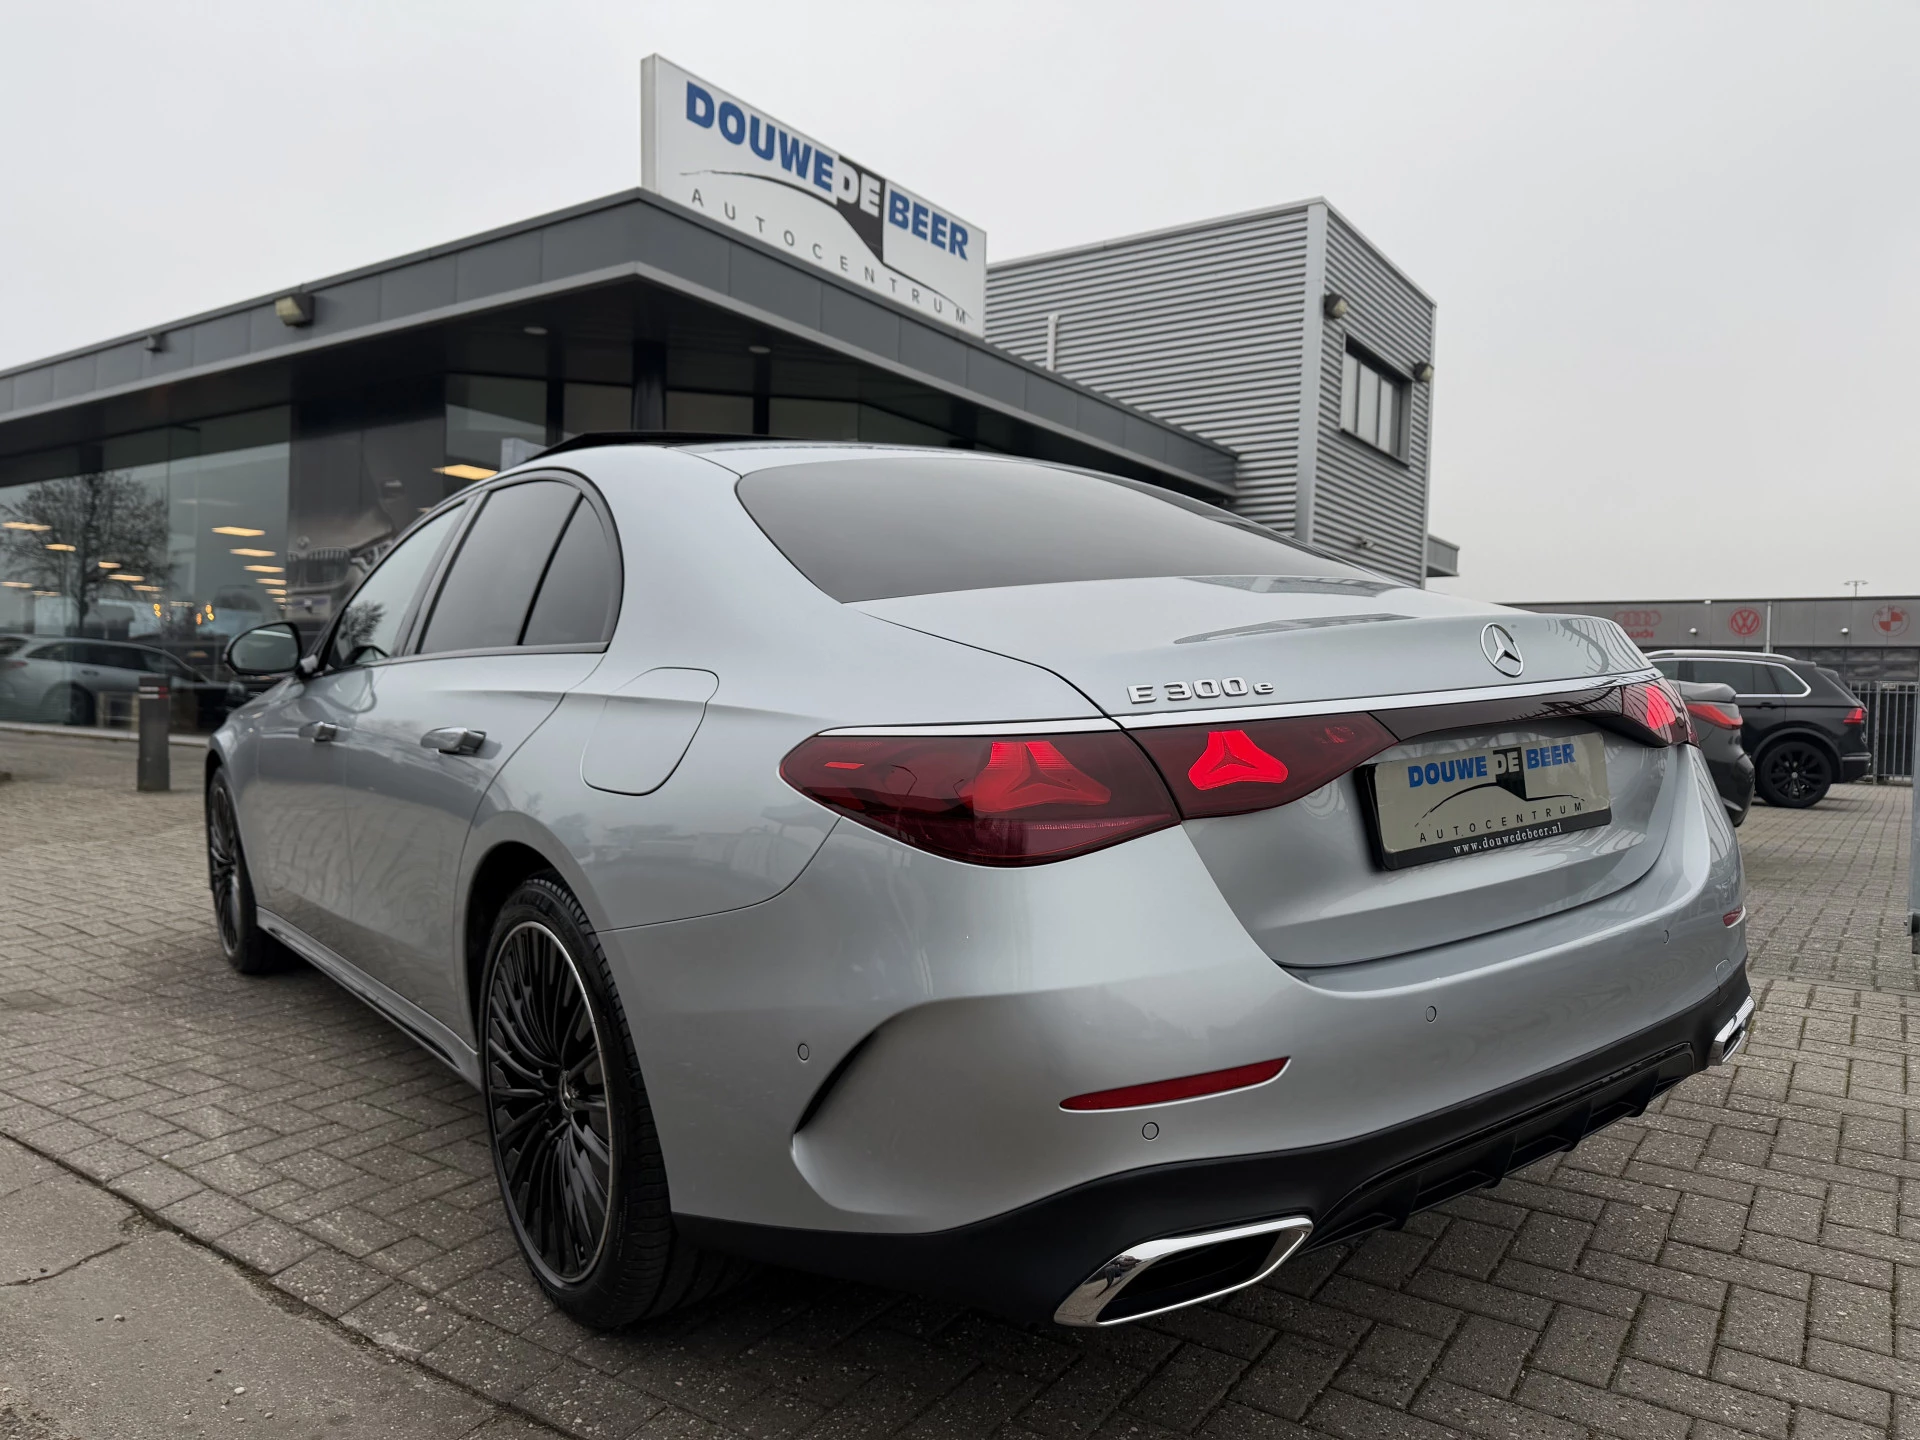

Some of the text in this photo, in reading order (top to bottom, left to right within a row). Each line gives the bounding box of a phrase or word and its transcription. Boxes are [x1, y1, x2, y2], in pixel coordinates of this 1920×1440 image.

[686, 80, 969, 261] DOUWE DE BEER
[691, 187, 967, 325] AUTOCENTRUM
[1127, 676, 1275, 704] E 300 e
[1407, 743, 1576, 788] DOUWE DE BEER
[1419, 802, 1583, 843] AUTOCENTRUM
[1453, 822, 1563, 855] www.douwedebeer.nl
